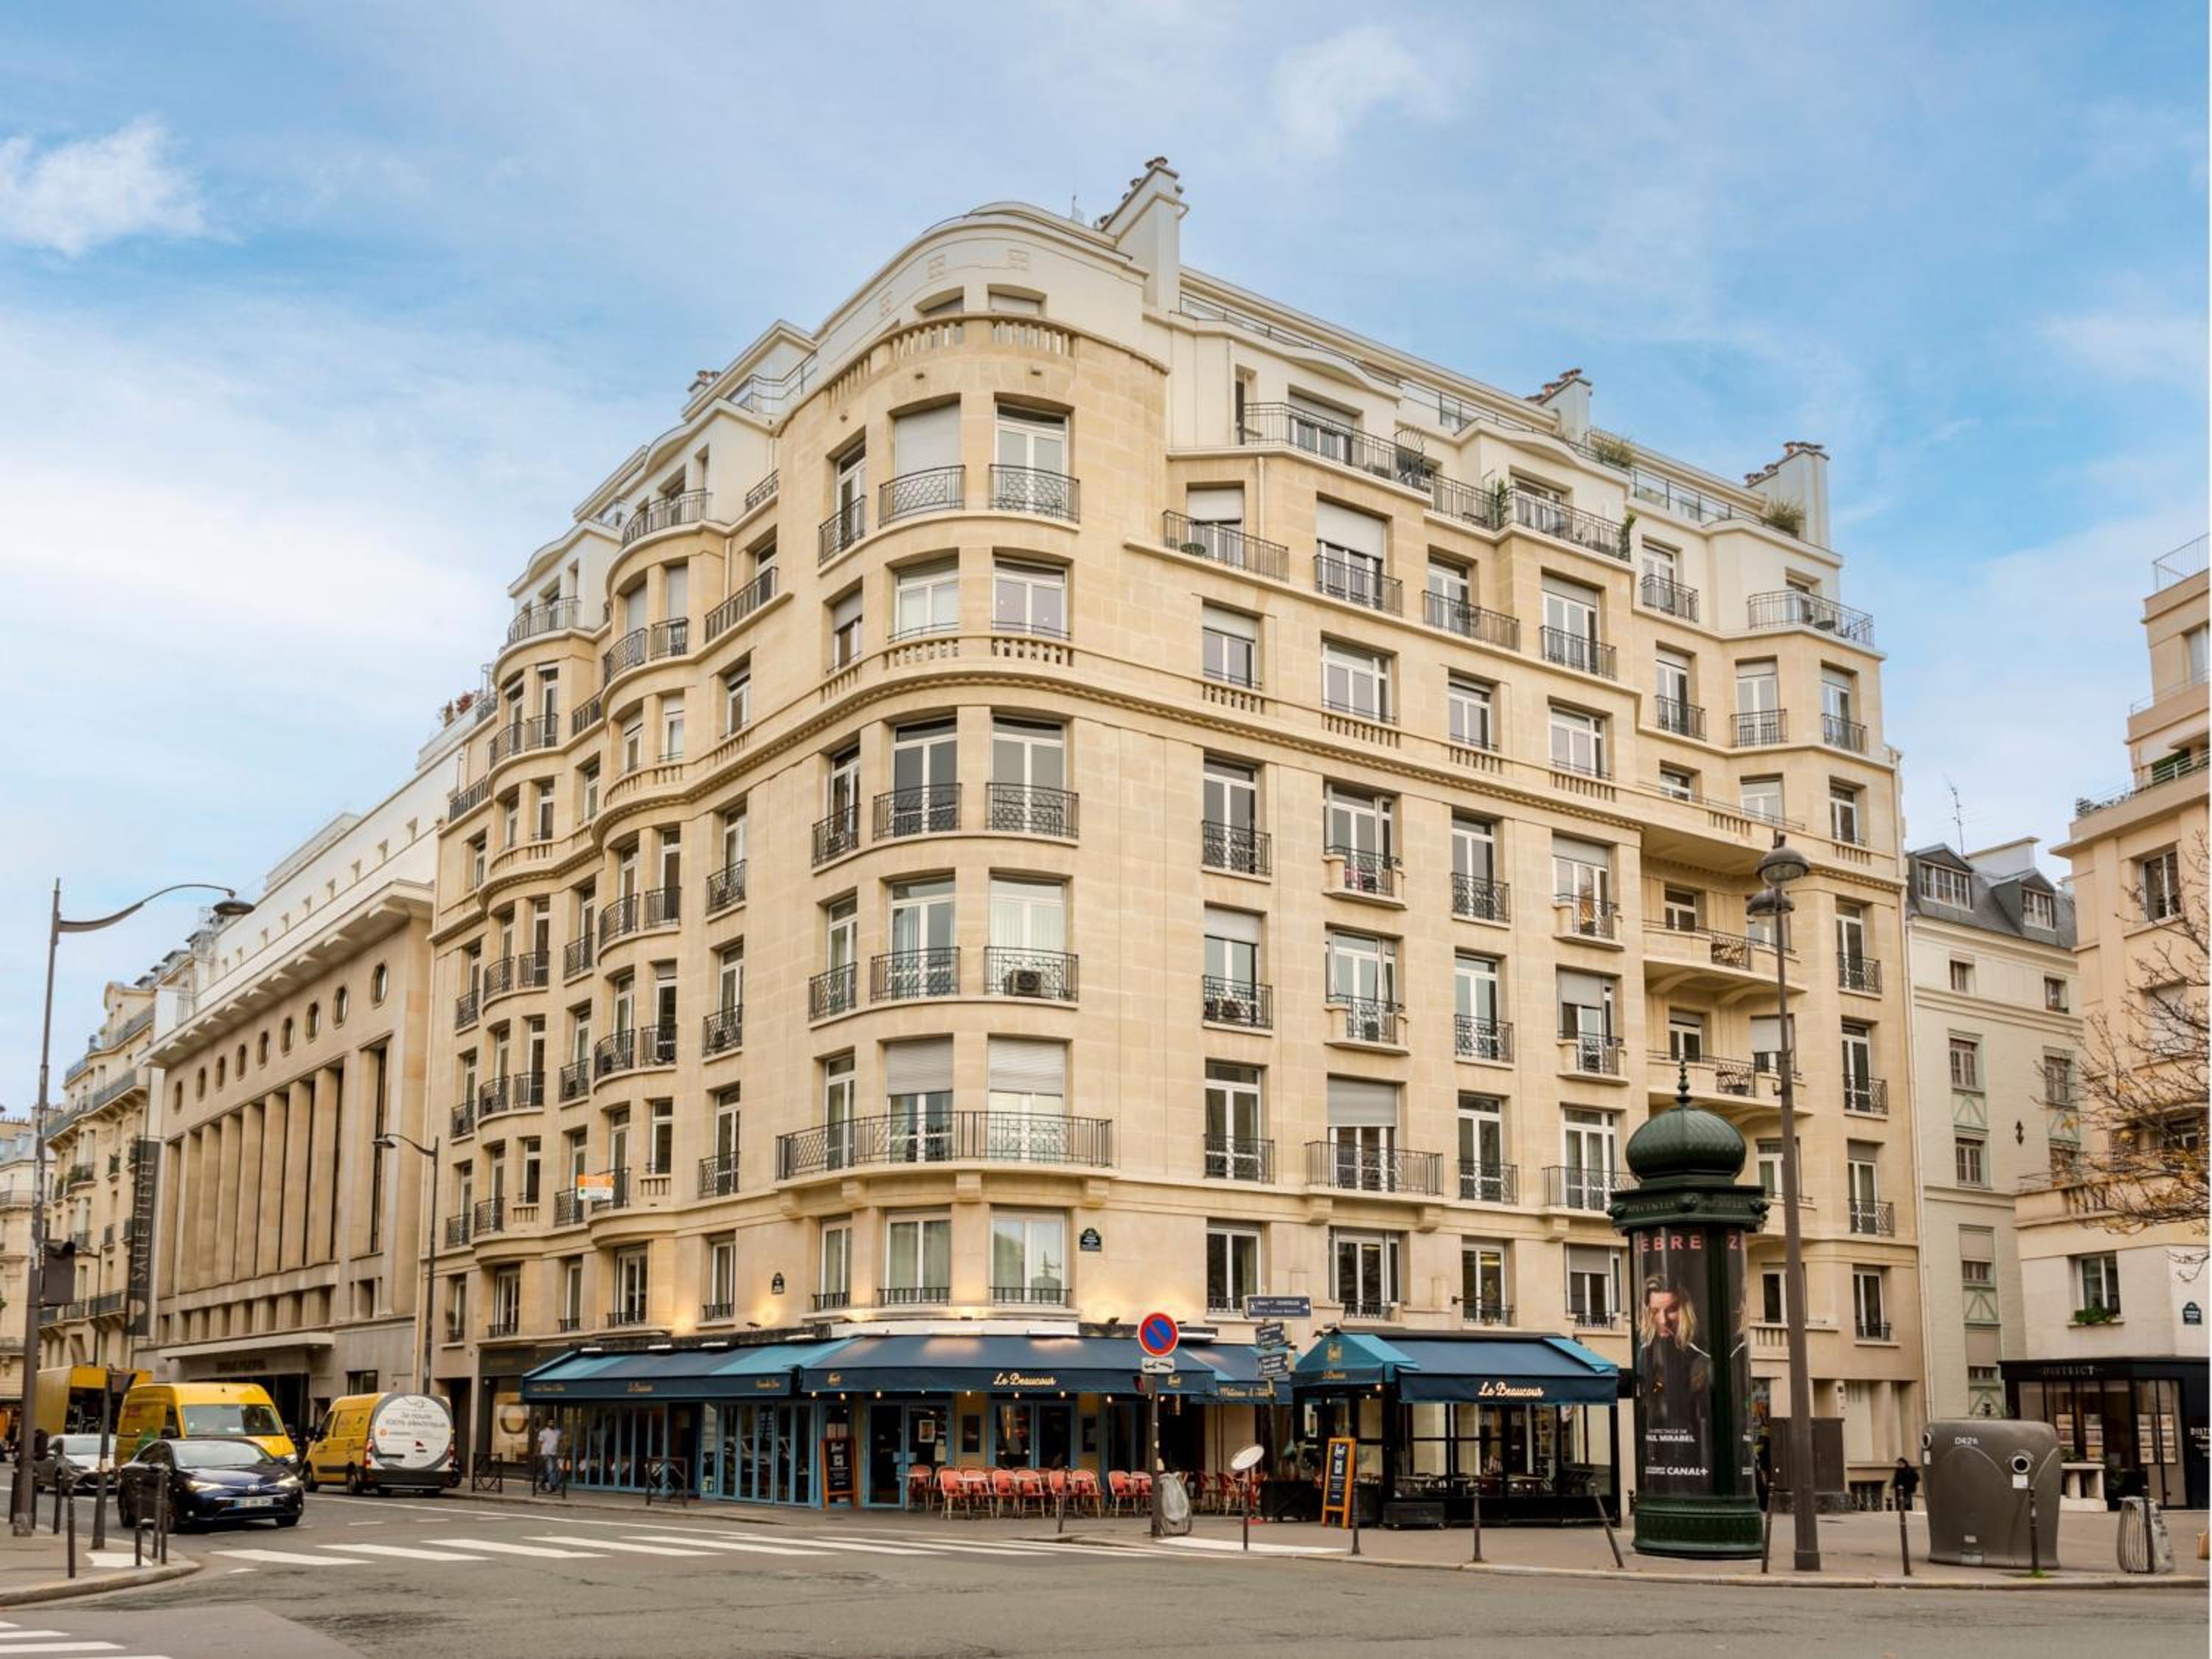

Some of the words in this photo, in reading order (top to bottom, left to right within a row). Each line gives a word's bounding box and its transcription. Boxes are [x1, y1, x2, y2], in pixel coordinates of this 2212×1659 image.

[135, 1158, 155, 1220] PLEYEL
[131, 1228, 150, 1282] SALLE
[1478, 1381, 1495, 1396] Le
[1495, 1381, 1545, 1397] Beaucour
[1659, 1434, 1695, 1442] MIRABEL
[1666, 1467, 1709, 1476] CANAL+
